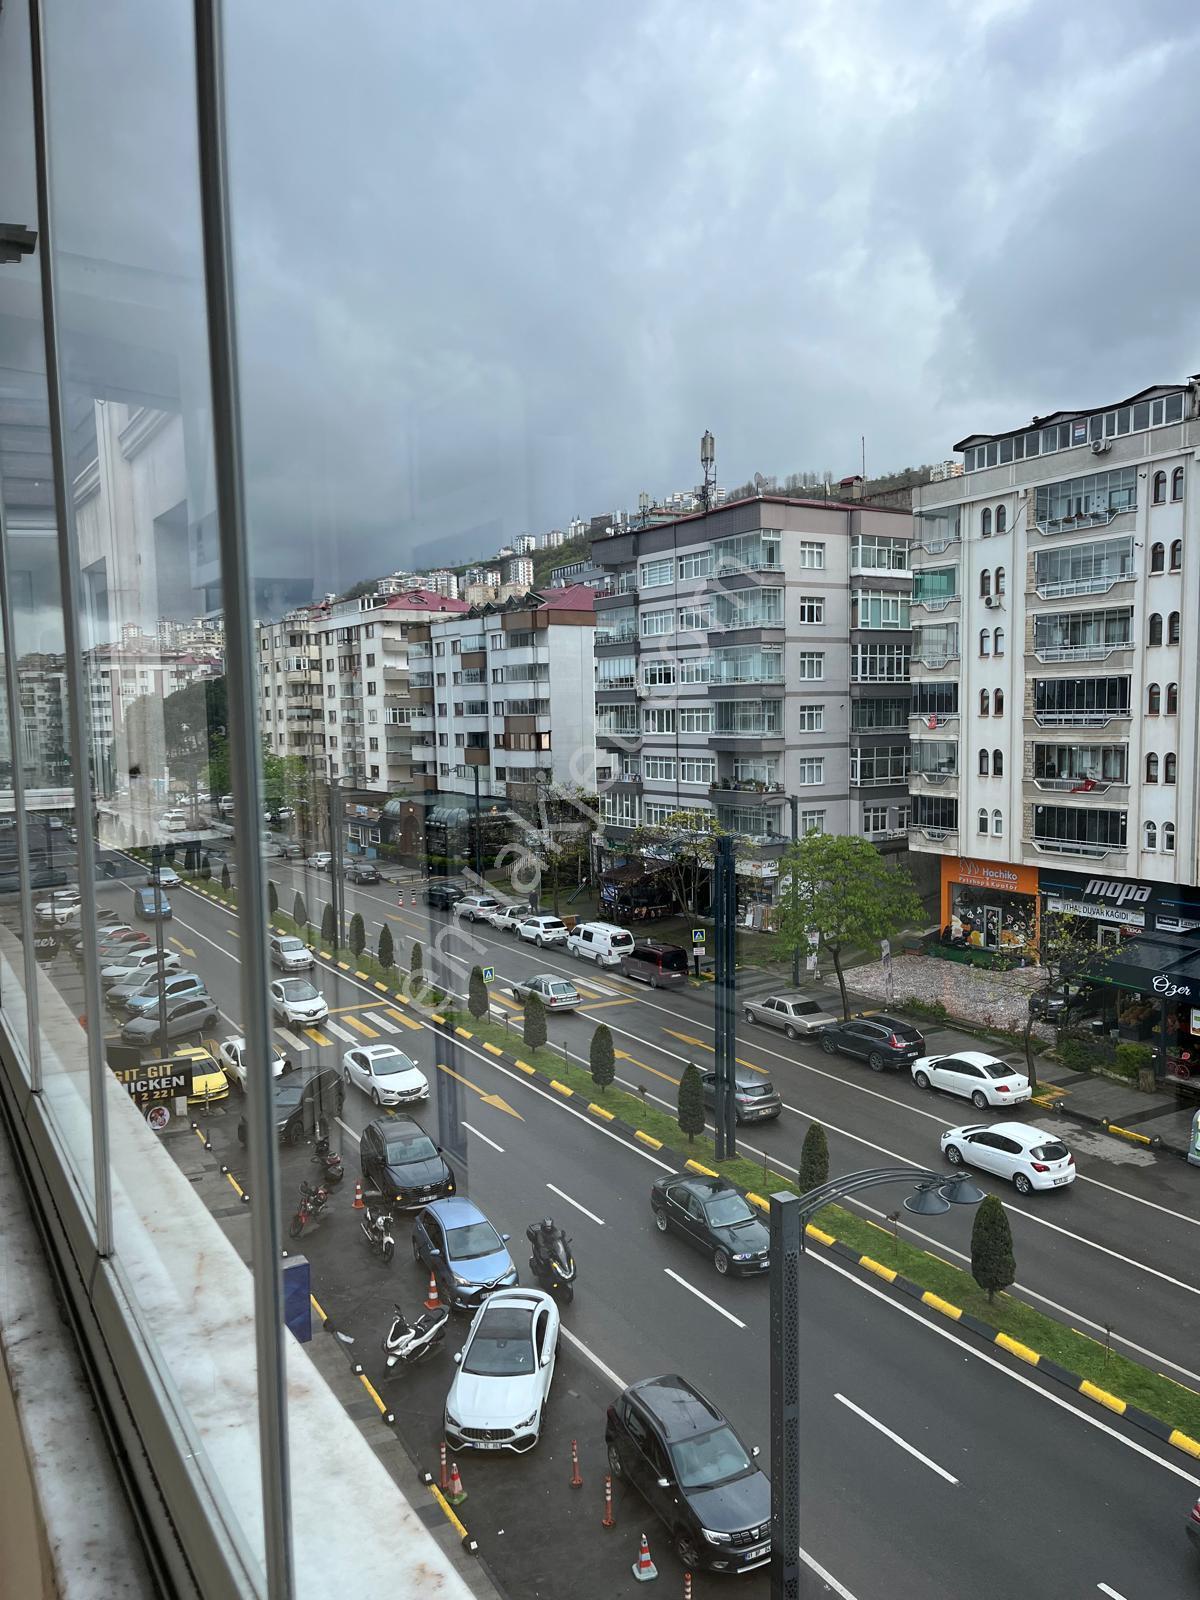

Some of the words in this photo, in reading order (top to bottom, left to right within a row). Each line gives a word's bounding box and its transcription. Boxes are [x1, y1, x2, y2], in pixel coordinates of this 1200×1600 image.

[982, 868, 1018, 880] Hachiko
[1085, 879, 1152, 906] mopa
[1152, 974, 1192, 997] Özer
